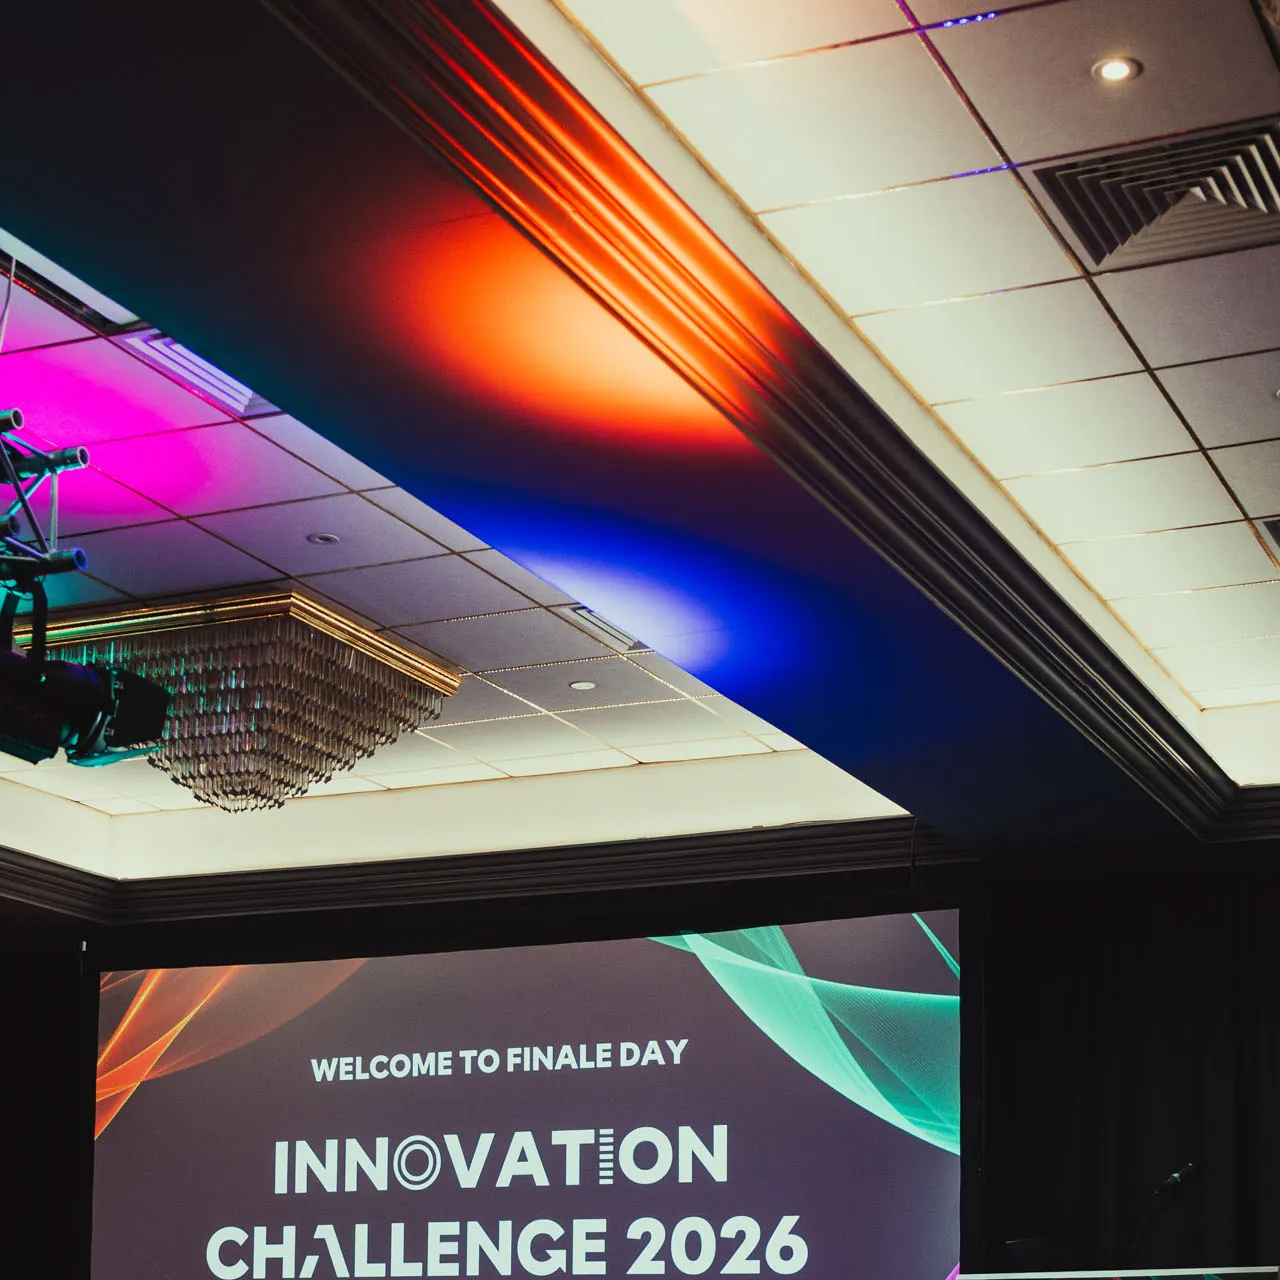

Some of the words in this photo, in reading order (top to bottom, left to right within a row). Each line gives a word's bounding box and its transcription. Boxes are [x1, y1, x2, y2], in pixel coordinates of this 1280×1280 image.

[311, 1051, 452, 1081] WELCOME
[459, 1049, 500, 1074] TO
[507, 1043, 611, 1072] FINALE
[620, 1039, 688, 1066] DAY
[275, 1125, 727, 1194] INNOVATION
[207, 1219, 606, 1280] CHALLENGE
[626, 1216, 808, 1275] 2026
